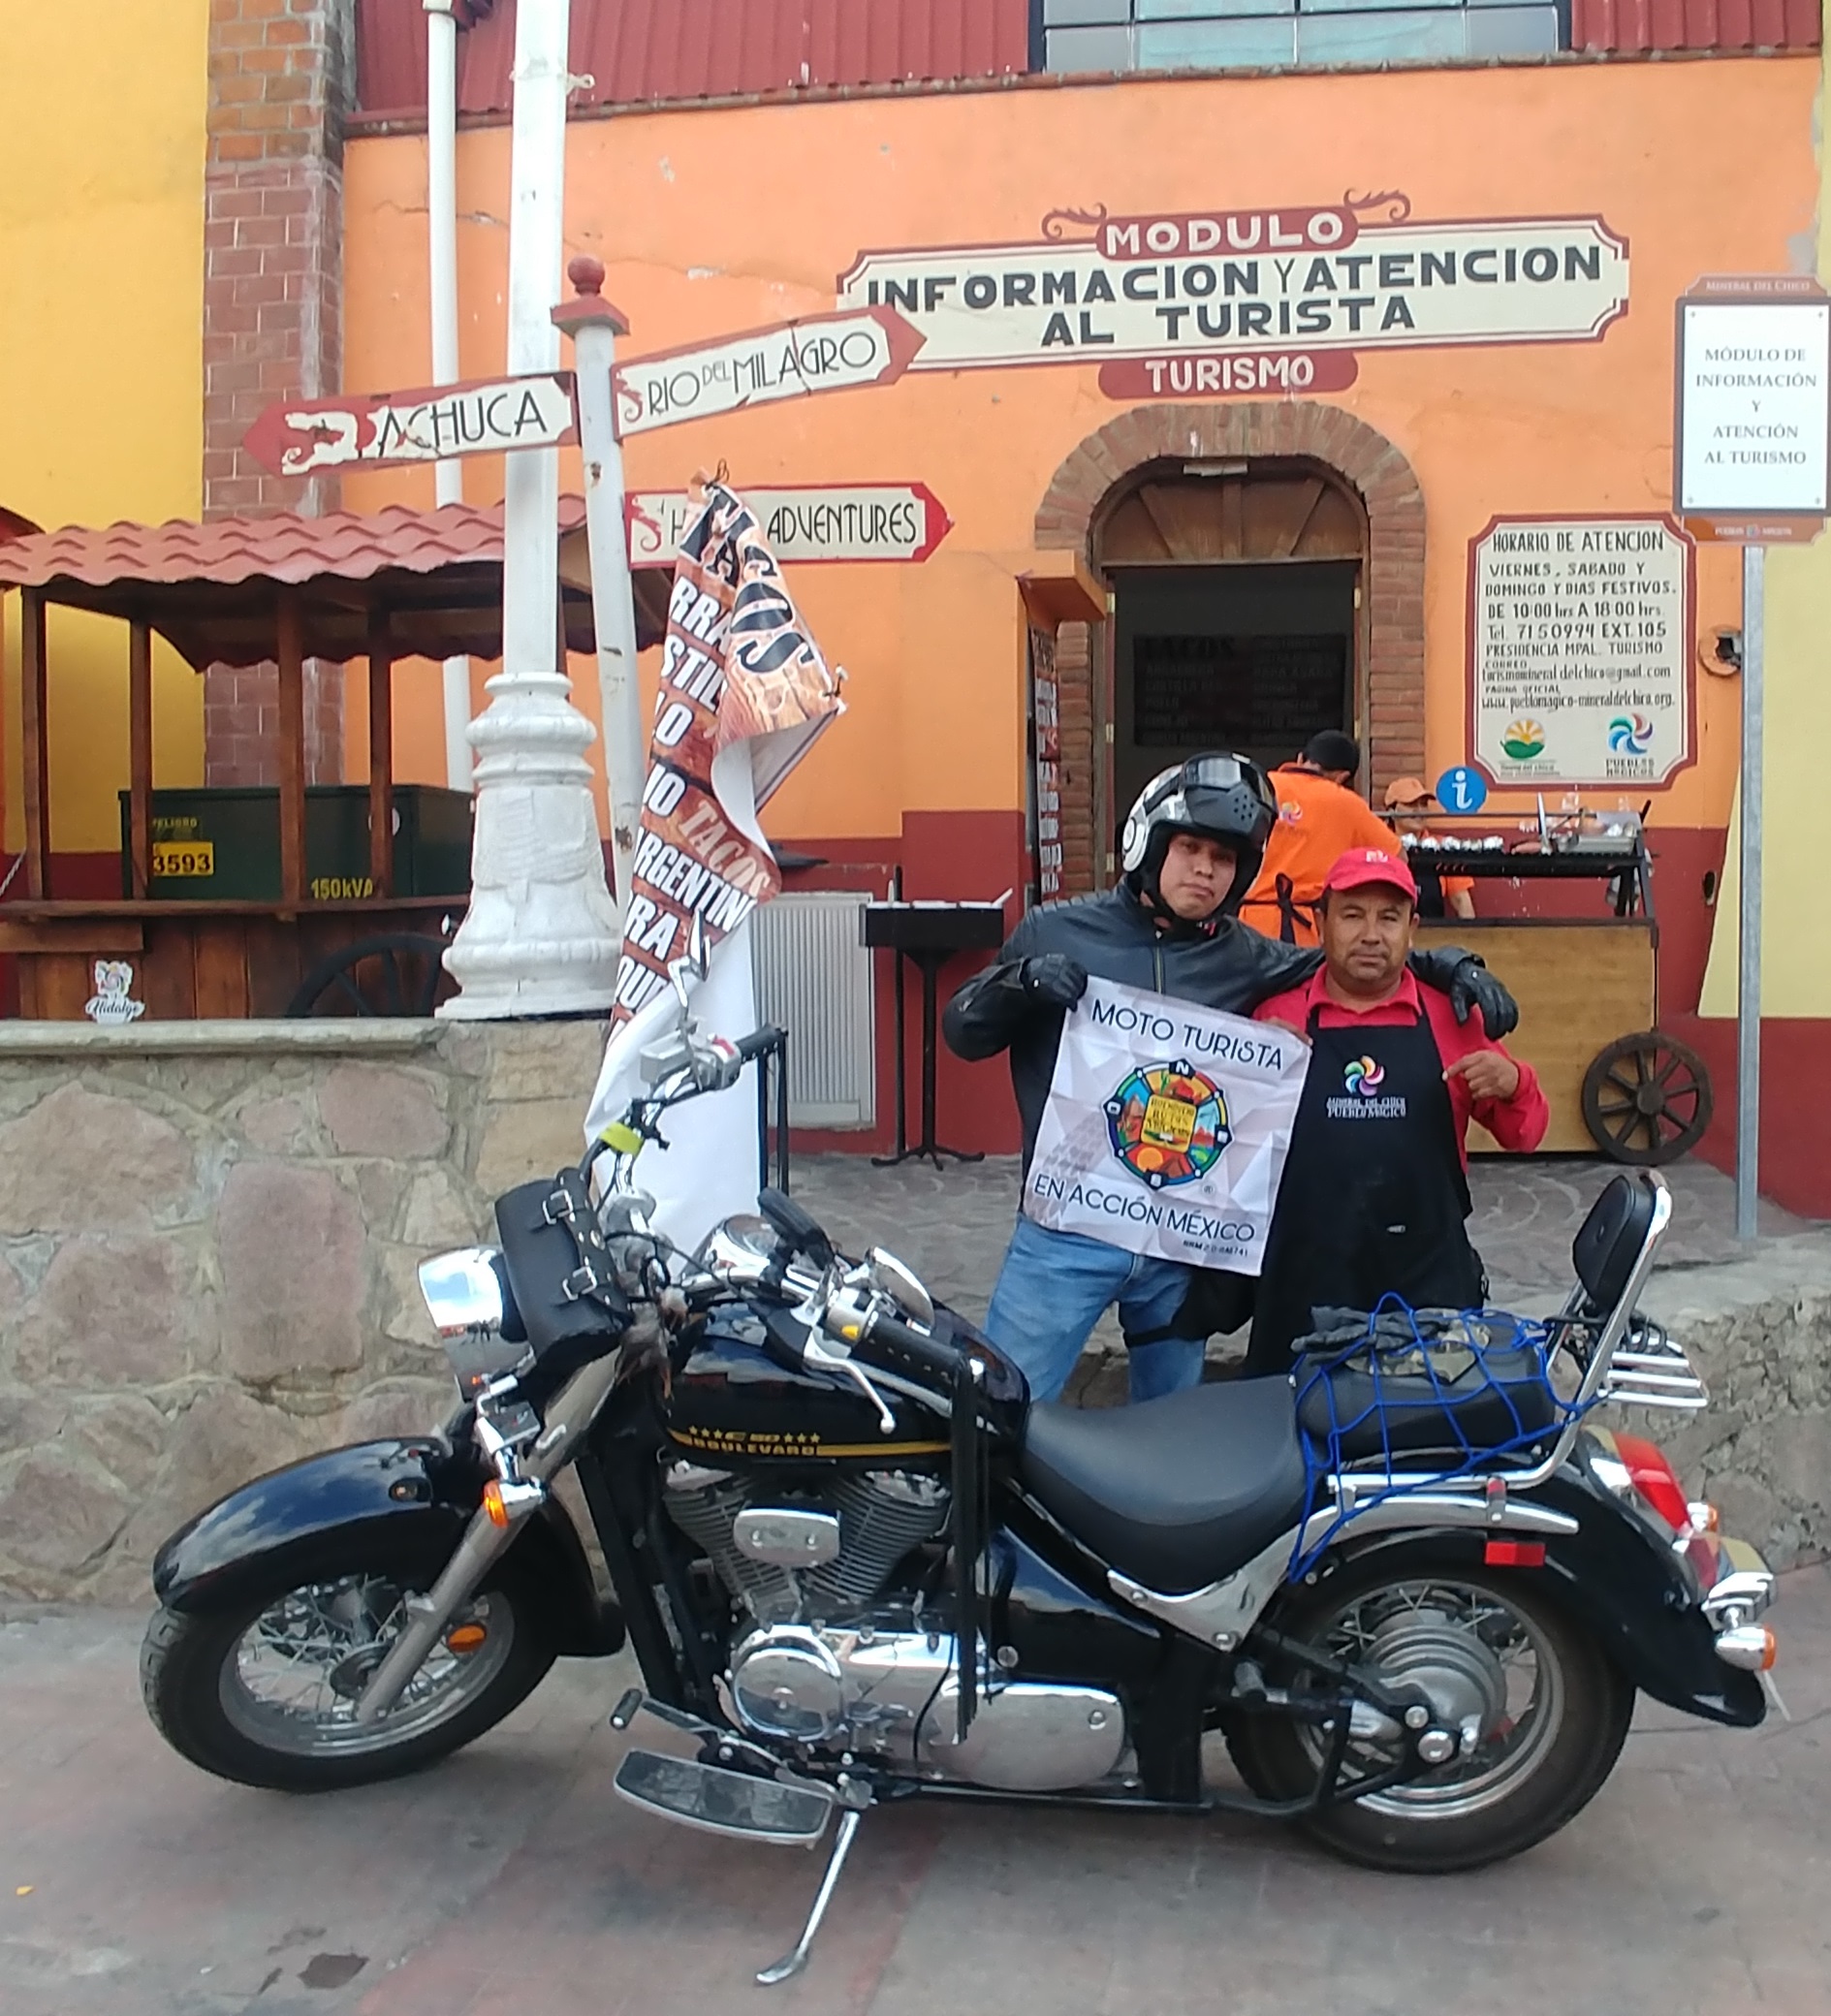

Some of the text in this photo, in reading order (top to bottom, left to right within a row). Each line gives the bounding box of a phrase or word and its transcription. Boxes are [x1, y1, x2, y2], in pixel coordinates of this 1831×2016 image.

[1106, 212, 1342, 256] MODULO
[868, 245, 1600, 313] INFORMACION Y ATENCION
[1041, 296, 1415, 347] AL TURISTA
[1704, 345, 1807, 362] MÓDULO DE
[648, 331, 876, 416] RIO DEL MILAGRO
[1145, 355, 1314, 393] TURISMO
[1696, 371, 1817, 388] INFORMACIÓN
[1752, 399, 1762, 413] Y
[376, 390, 548, 458] ACHUCA
[1713, 423, 1799, 439] ATENCIÓN
[1704, 451, 1807, 465] AL TURISMO
[767, 502, 916, 546] ADVENTURES
[1493, 530, 1664, 553] HORARIO DE ATENCION
[1567, 561, 1626, 577] SABADO
[1636, 561, 1646, 576] Y
[1485, 583, 1546, 597] DOMINGO
[1554, 583, 1562, 596] Y
[1565, 583, 1595, 596] DIAS
[1488, 602, 1505, 619] DE
[1577, 601, 1589, 617] A
[1485, 643, 1559, 658] PRESIDENCIA
[1608, 641, 1663, 656] TURISMO
[153, 853, 210, 873] 3593
[1091, 998, 1282, 1071] MOTO TURISTA
[1175, 1061, 1189, 1075] N
[1033, 1172, 1254, 1243] EN ACCIÓN MÉXICO
[694, 1437, 815, 1456] BOULEVARD
